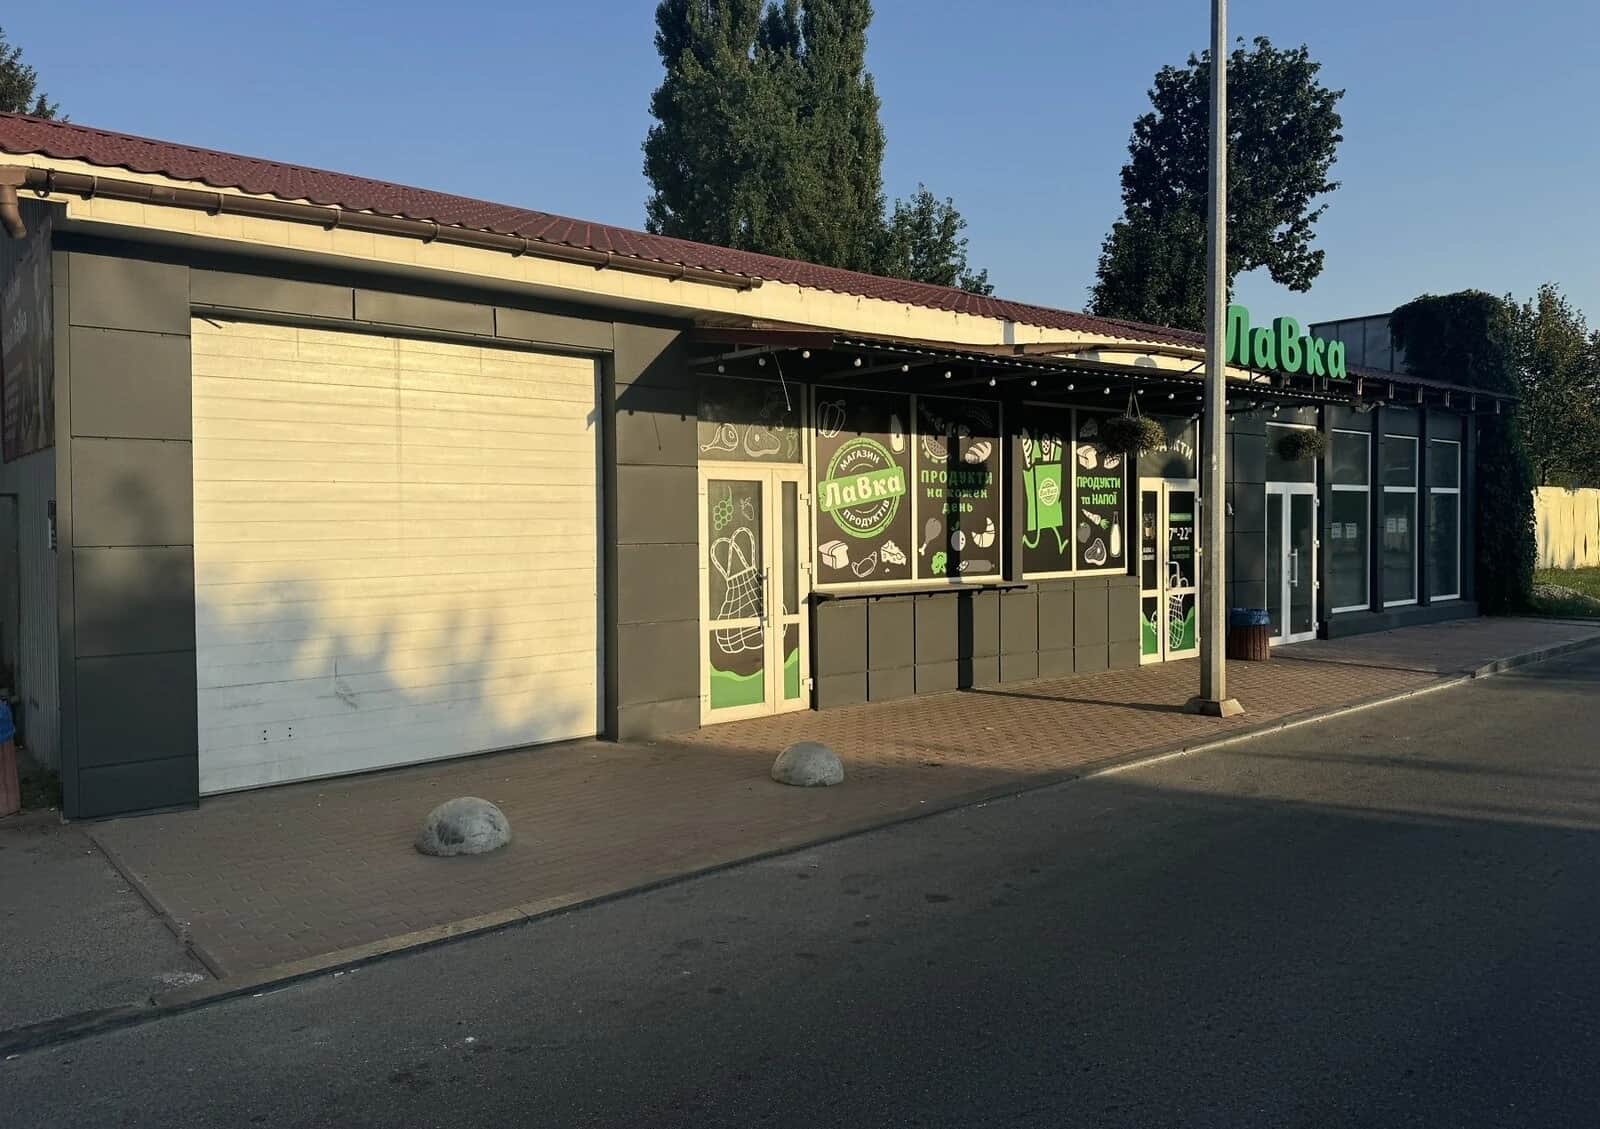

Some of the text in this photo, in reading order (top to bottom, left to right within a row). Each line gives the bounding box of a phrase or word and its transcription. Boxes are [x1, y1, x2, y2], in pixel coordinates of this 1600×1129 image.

[1226, 304, 1347, 379] ЛаВка
[840, 449, 880, 471] МАГАЗИН
[921, 470, 993, 486] ПРОДУКТИ
[1076, 476, 1121, 490] ПРОДУКТИ
[825, 476, 902, 508] ЛаВка
[927, 487, 943, 498] на
[1081, 491, 1117, 505] та НАПОЇ
[843, 500, 890, 528] ПРОДУКТІВ
[942, 502, 973, 515] день
